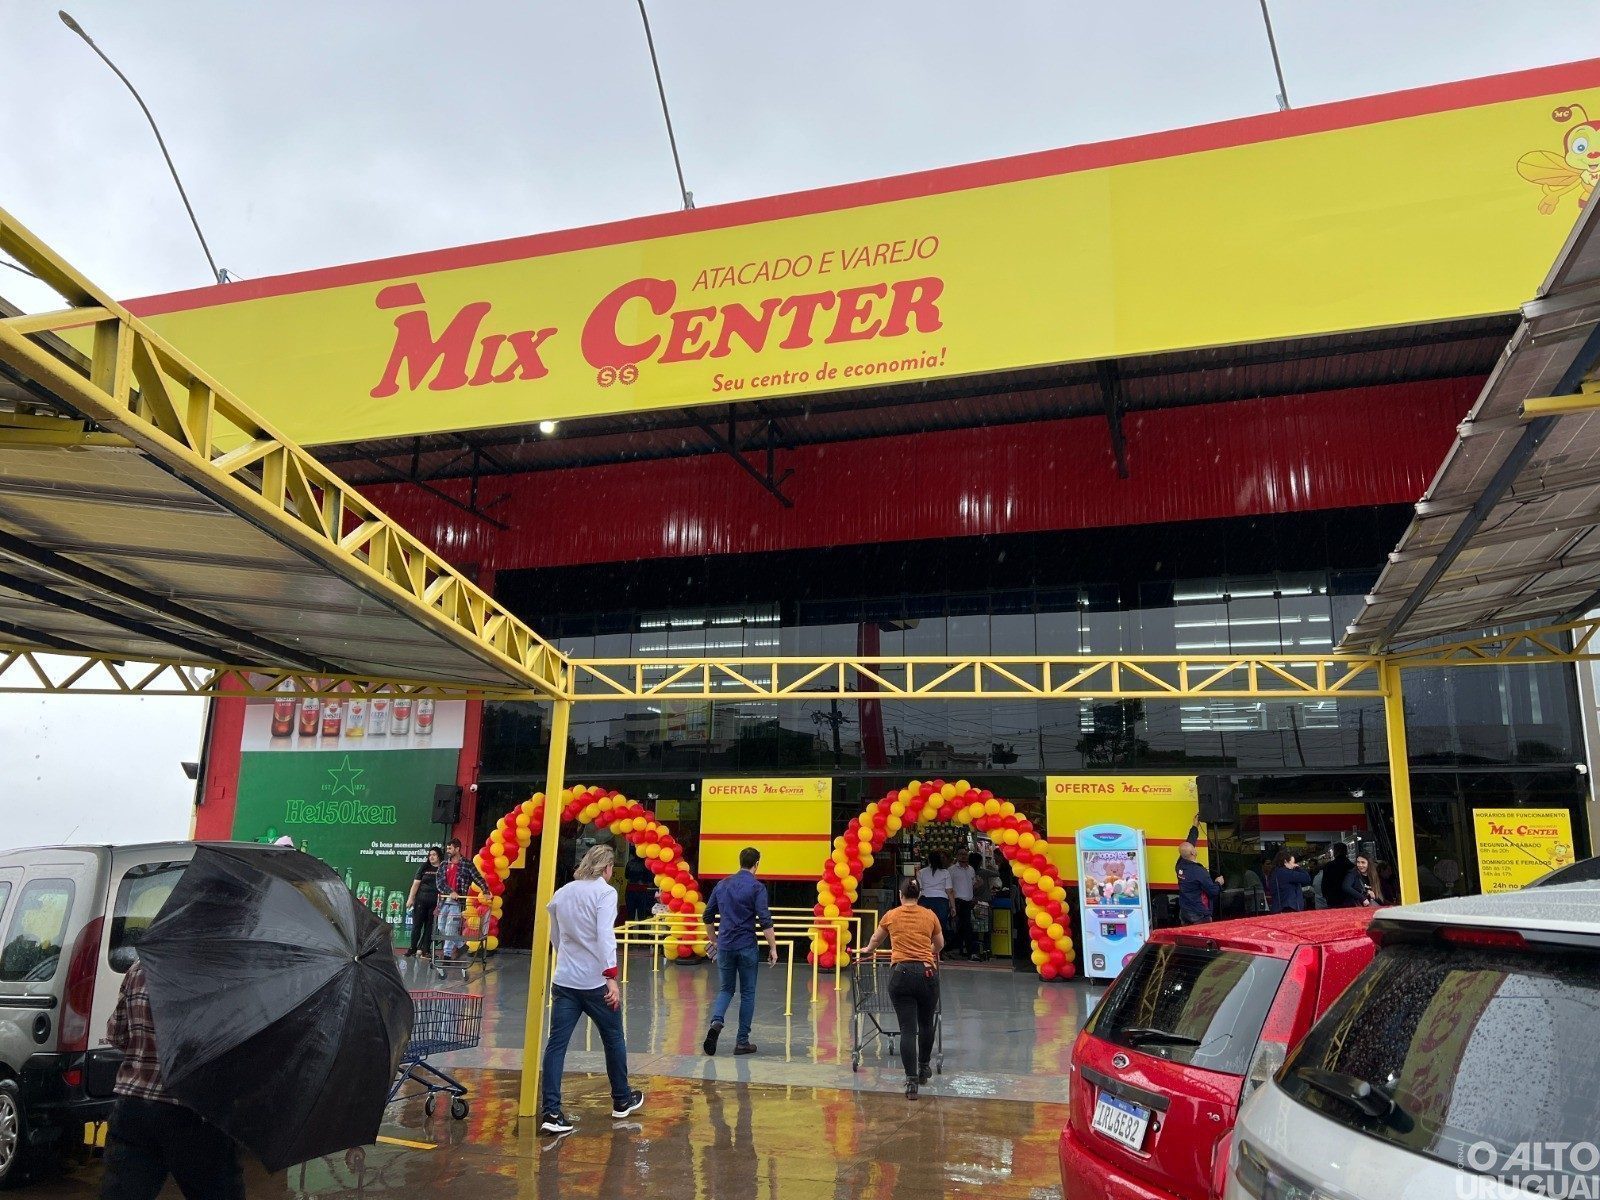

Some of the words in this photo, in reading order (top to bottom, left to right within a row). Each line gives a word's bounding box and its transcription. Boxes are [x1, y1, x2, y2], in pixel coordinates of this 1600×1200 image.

[692, 252, 813, 292] ATACADO
[818, 249, 836, 274] E
[841, 235, 940, 271] VAREJO
[581, 276, 945, 371] CENTER
[712, 373, 745, 393] Seu
[749, 366, 810, 389] centro
[815, 362, 839, 382] de
[843, 347, 947, 379] economia!
[709, 785, 758, 794] OFERTAS
[1055, 783, 1115, 794] OFERTAS
[285, 800, 397, 824] He150ken
[1096, 1104, 1140, 1143] IRL6E82
